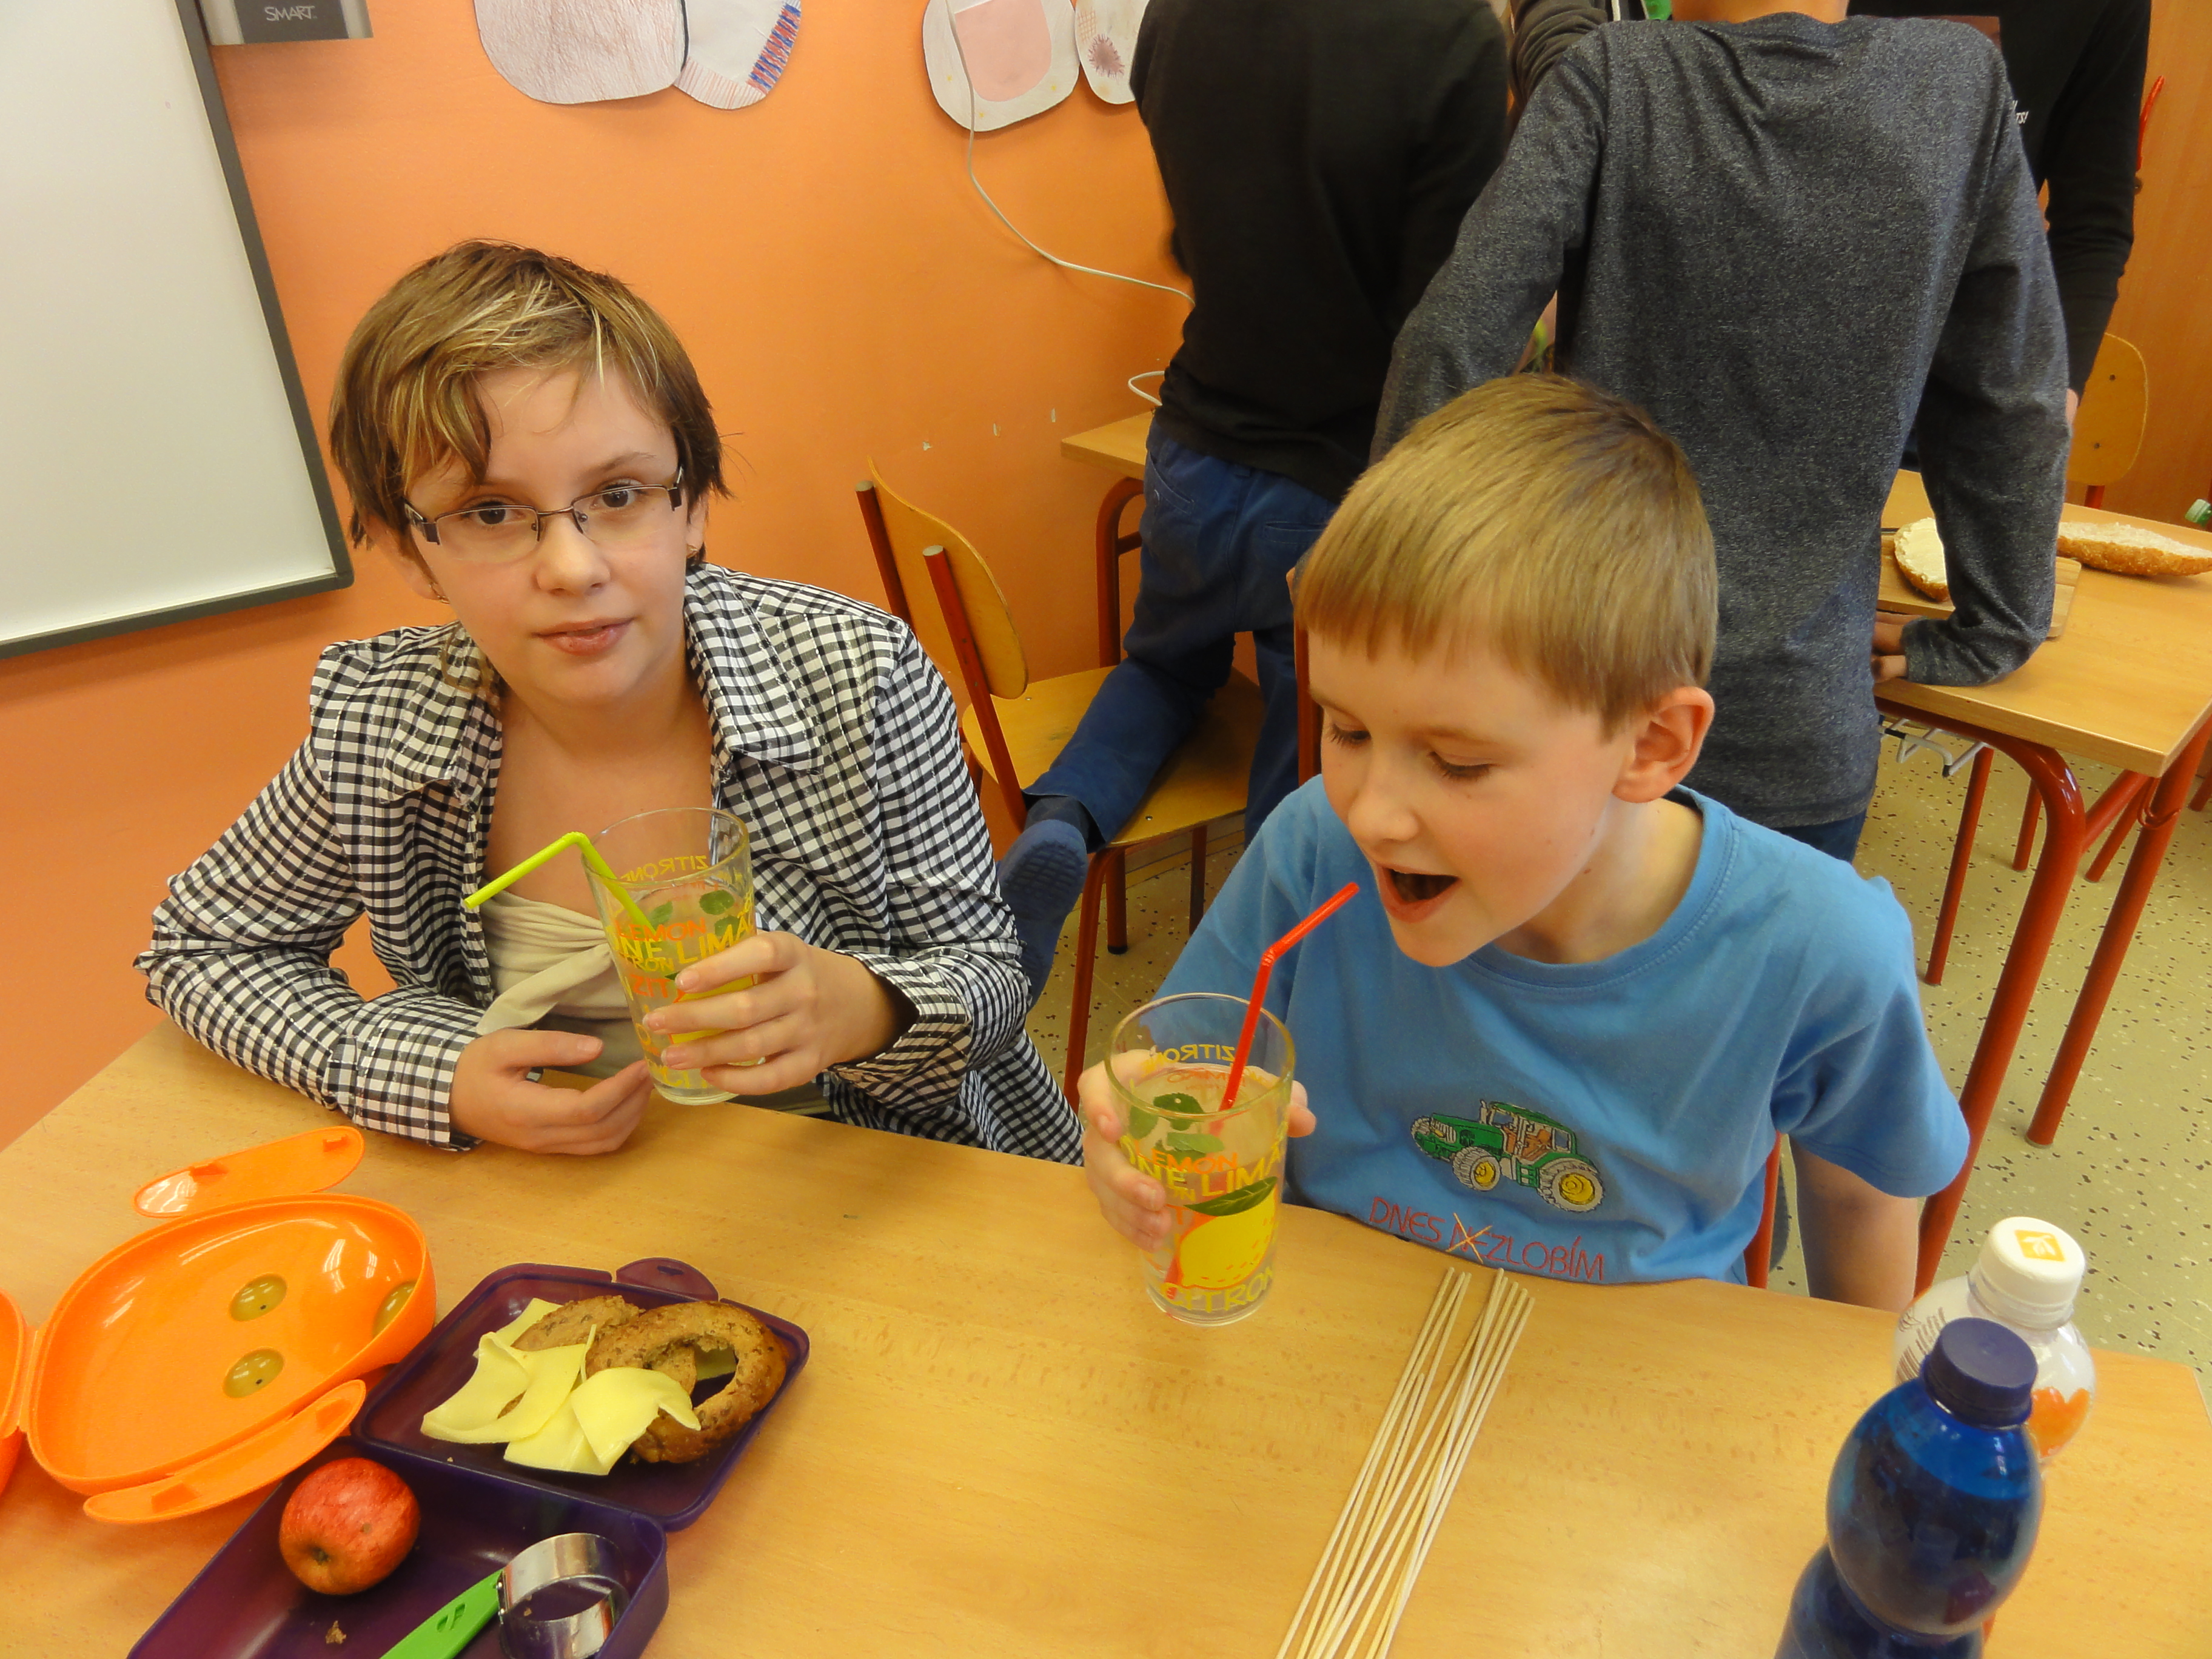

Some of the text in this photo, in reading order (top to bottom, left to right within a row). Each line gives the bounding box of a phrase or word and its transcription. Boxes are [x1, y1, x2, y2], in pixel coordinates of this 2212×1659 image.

[264, 5, 315, 21] SMART
[615, 917, 706, 942] LEMON
[1133, 1139, 1238, 1175] LEMON
[1369, 1196, 1446, 1243] DNES
